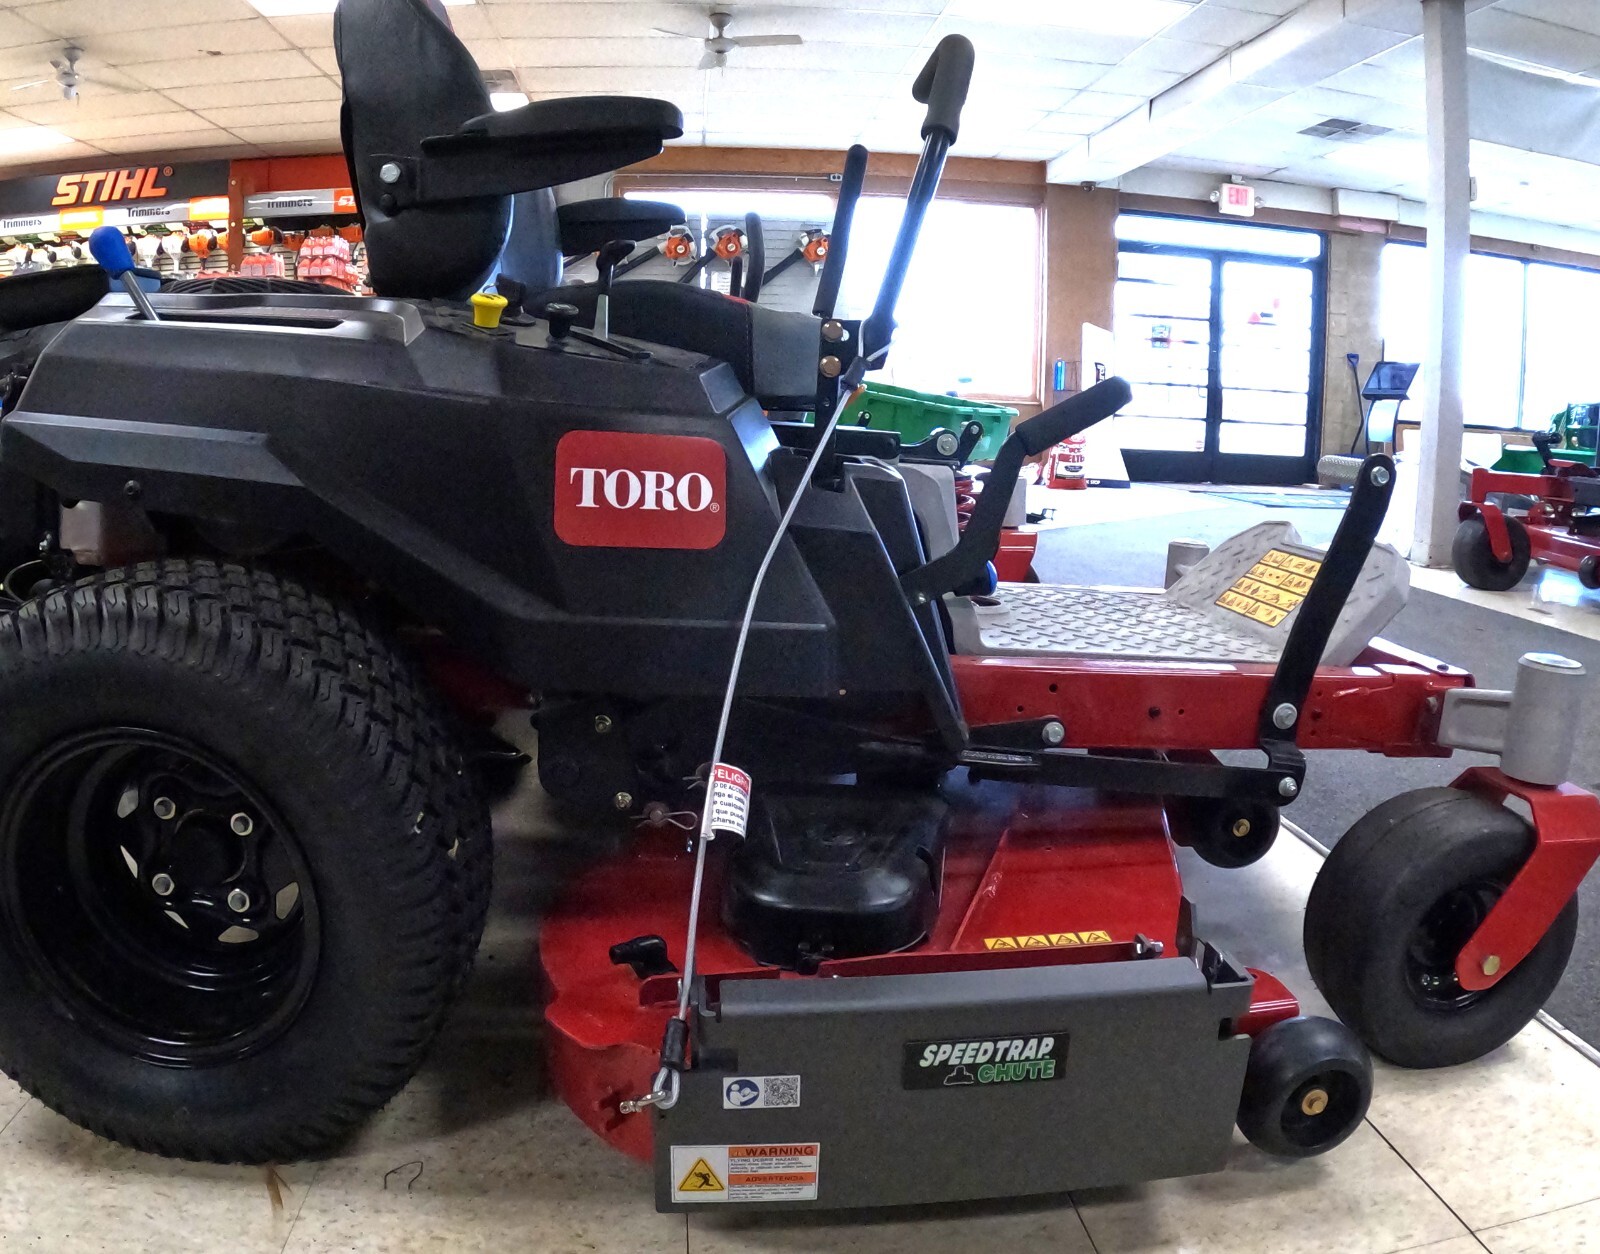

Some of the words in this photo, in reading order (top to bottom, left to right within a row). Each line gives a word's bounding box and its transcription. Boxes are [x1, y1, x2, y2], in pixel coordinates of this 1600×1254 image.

[51, 166, 168, 206] STIHL
[267, 198, 313, 208] Trimmers
[1228, 187, 1248, 206] EXIT
[126, 207, 171, 218] Trimmers
[3, 219, 42, 229] Trimmers
[569, 467, 714, 512] TORO
[919, 1037, 1055, 1067] SPEEDTRAP
[977, 1059, 1056, 1083] CHUTE
[745, 1146, 814, 1156] WARNING
